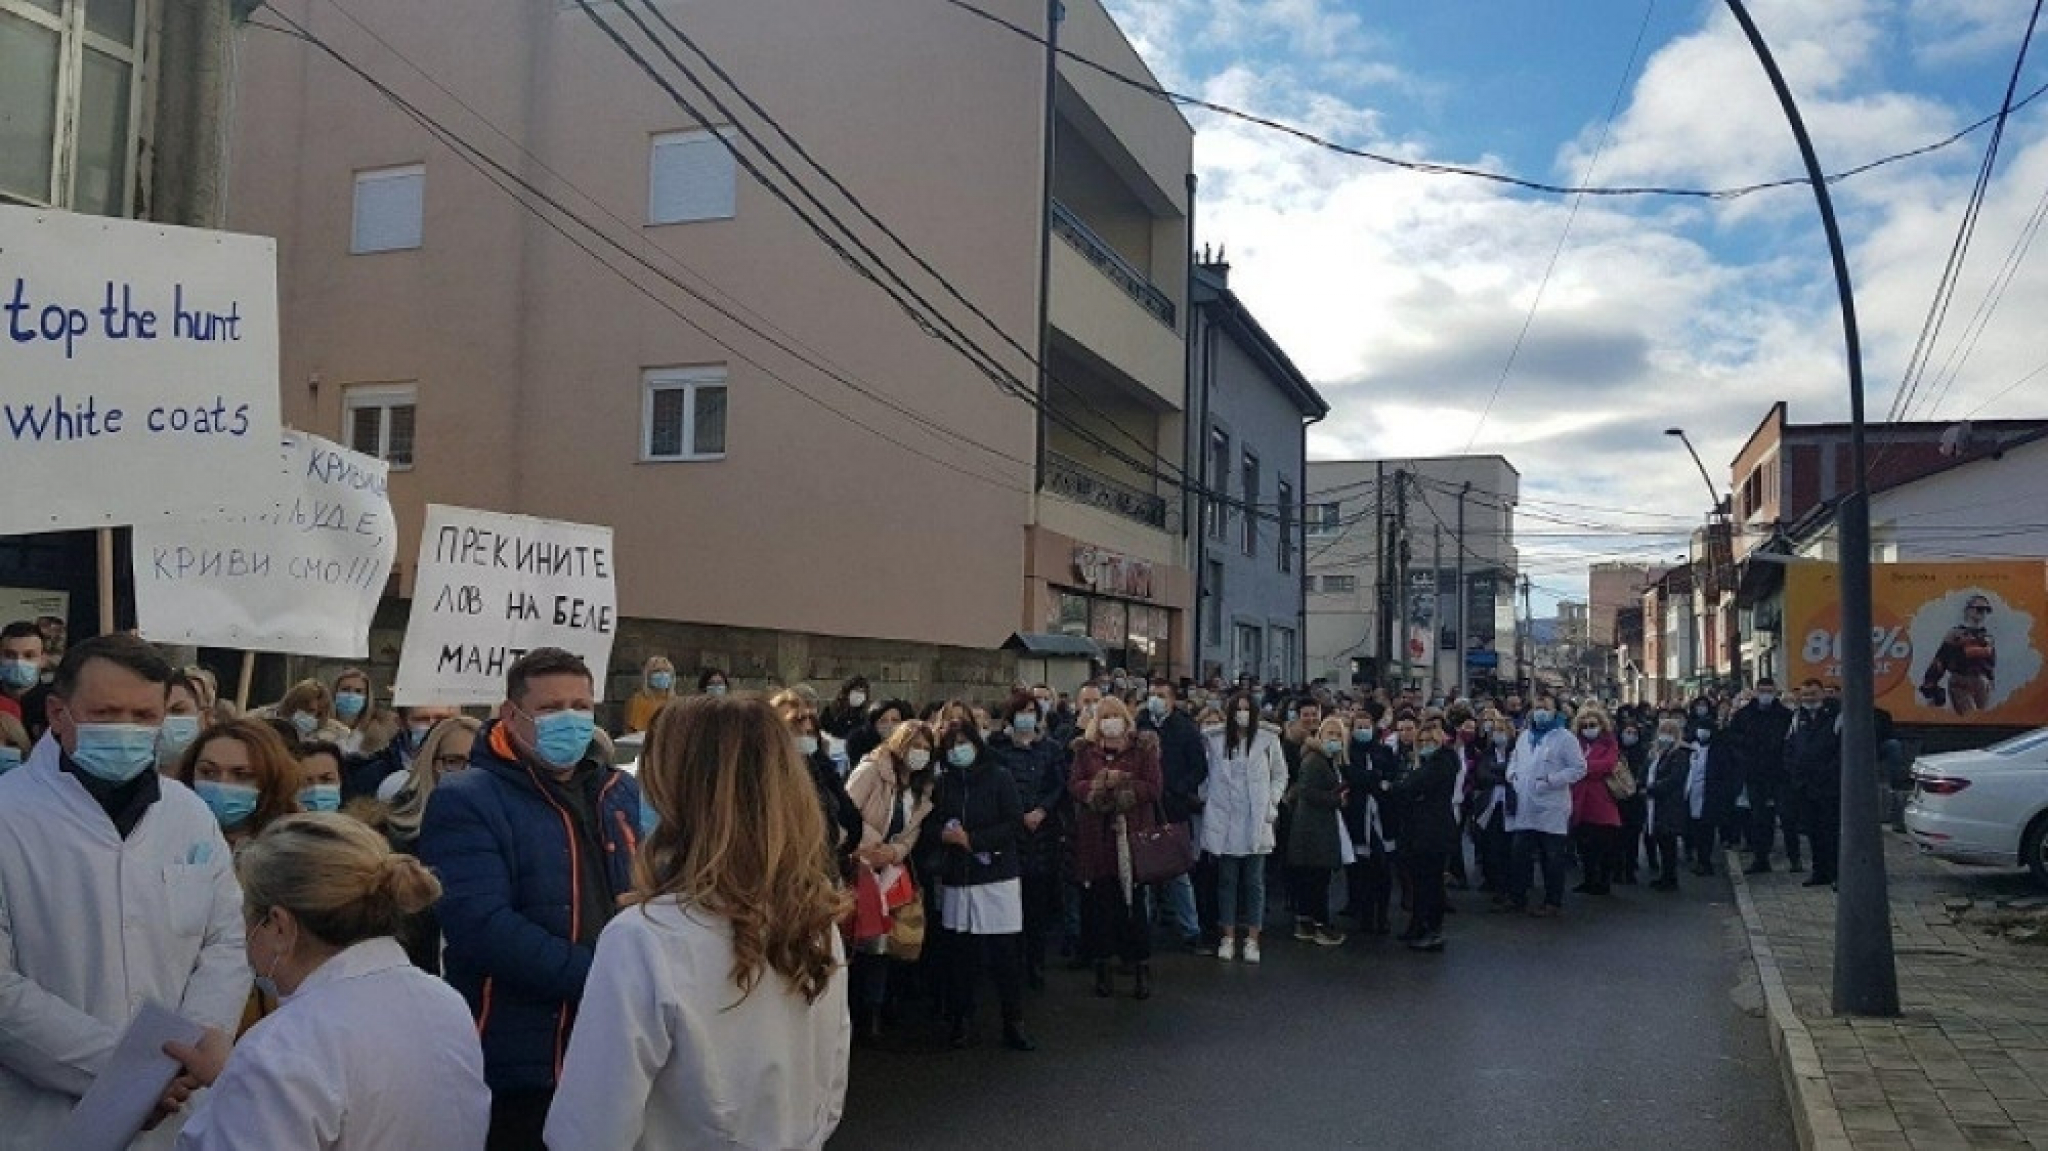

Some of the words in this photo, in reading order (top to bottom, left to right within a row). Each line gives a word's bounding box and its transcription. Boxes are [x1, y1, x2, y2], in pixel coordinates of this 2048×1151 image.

[4, 278, 88, 359] top
[99, 281, 157, 339] the
[173, 284, 242, 341] hunt
[147, 396, 249, 435] coats
[153, 546, 271, 581] КРИВИ
[436, 526, 608, 578] ПРЕКИНИТЕ
[433, 583, 484, 615] ЛОВ
[506, 590, 541, 620] НА
[552, 595, 612, 633] БЕЛЕ
